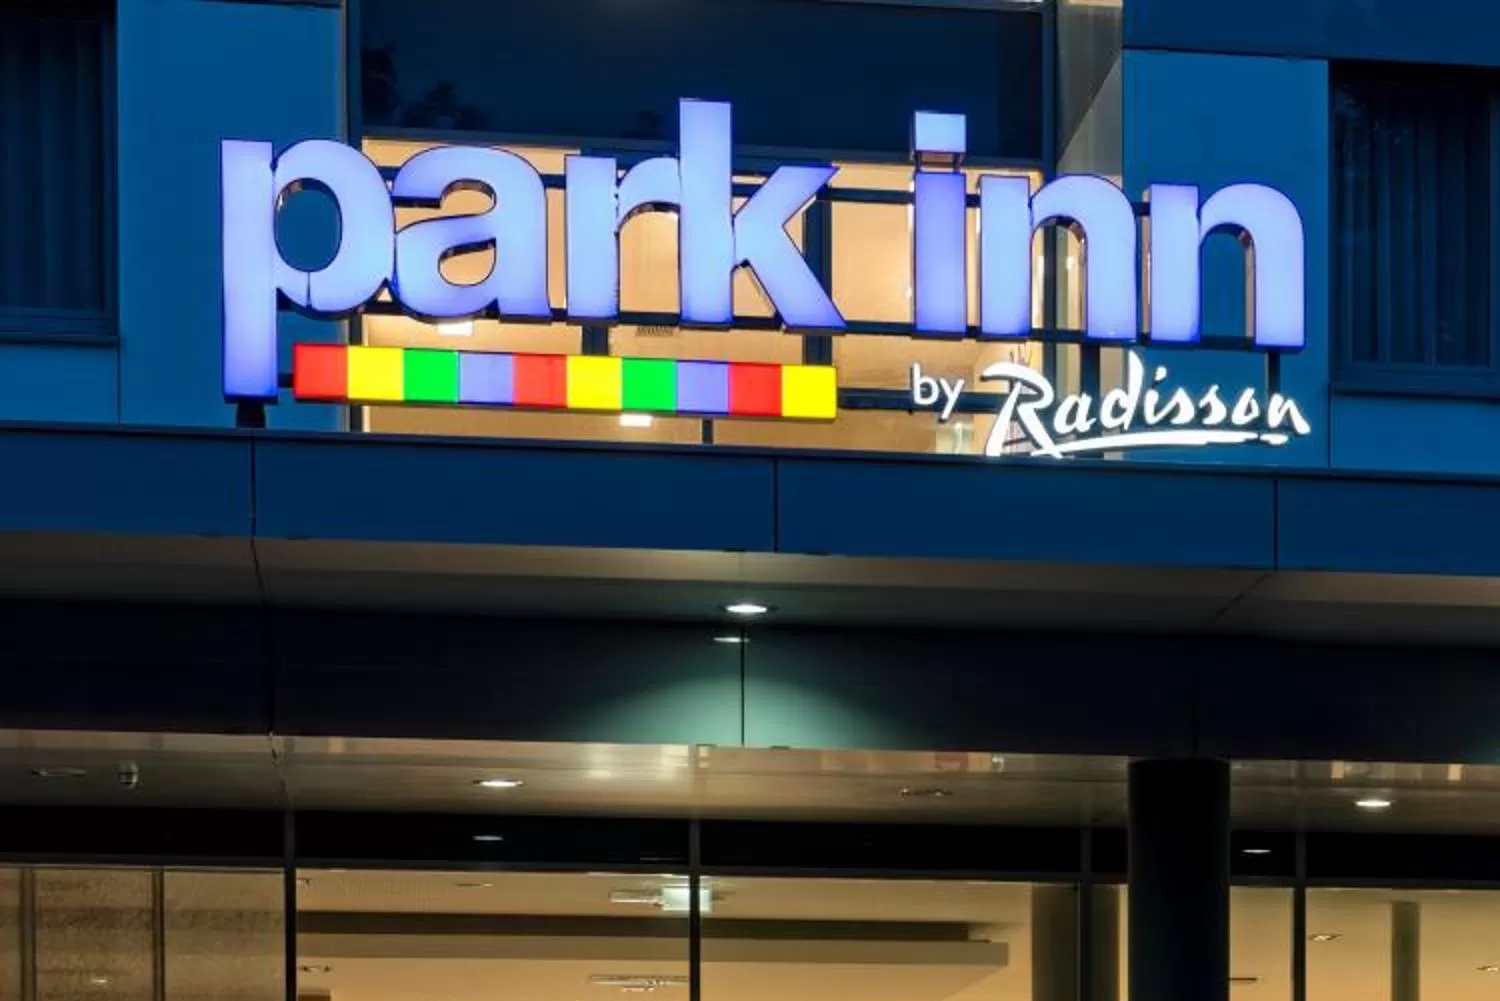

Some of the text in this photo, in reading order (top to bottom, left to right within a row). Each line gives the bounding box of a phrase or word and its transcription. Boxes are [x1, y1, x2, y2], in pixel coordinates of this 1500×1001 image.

[221, 98, 1306, 398] park inn
[911, 350, 1312, 458] by Radisson
